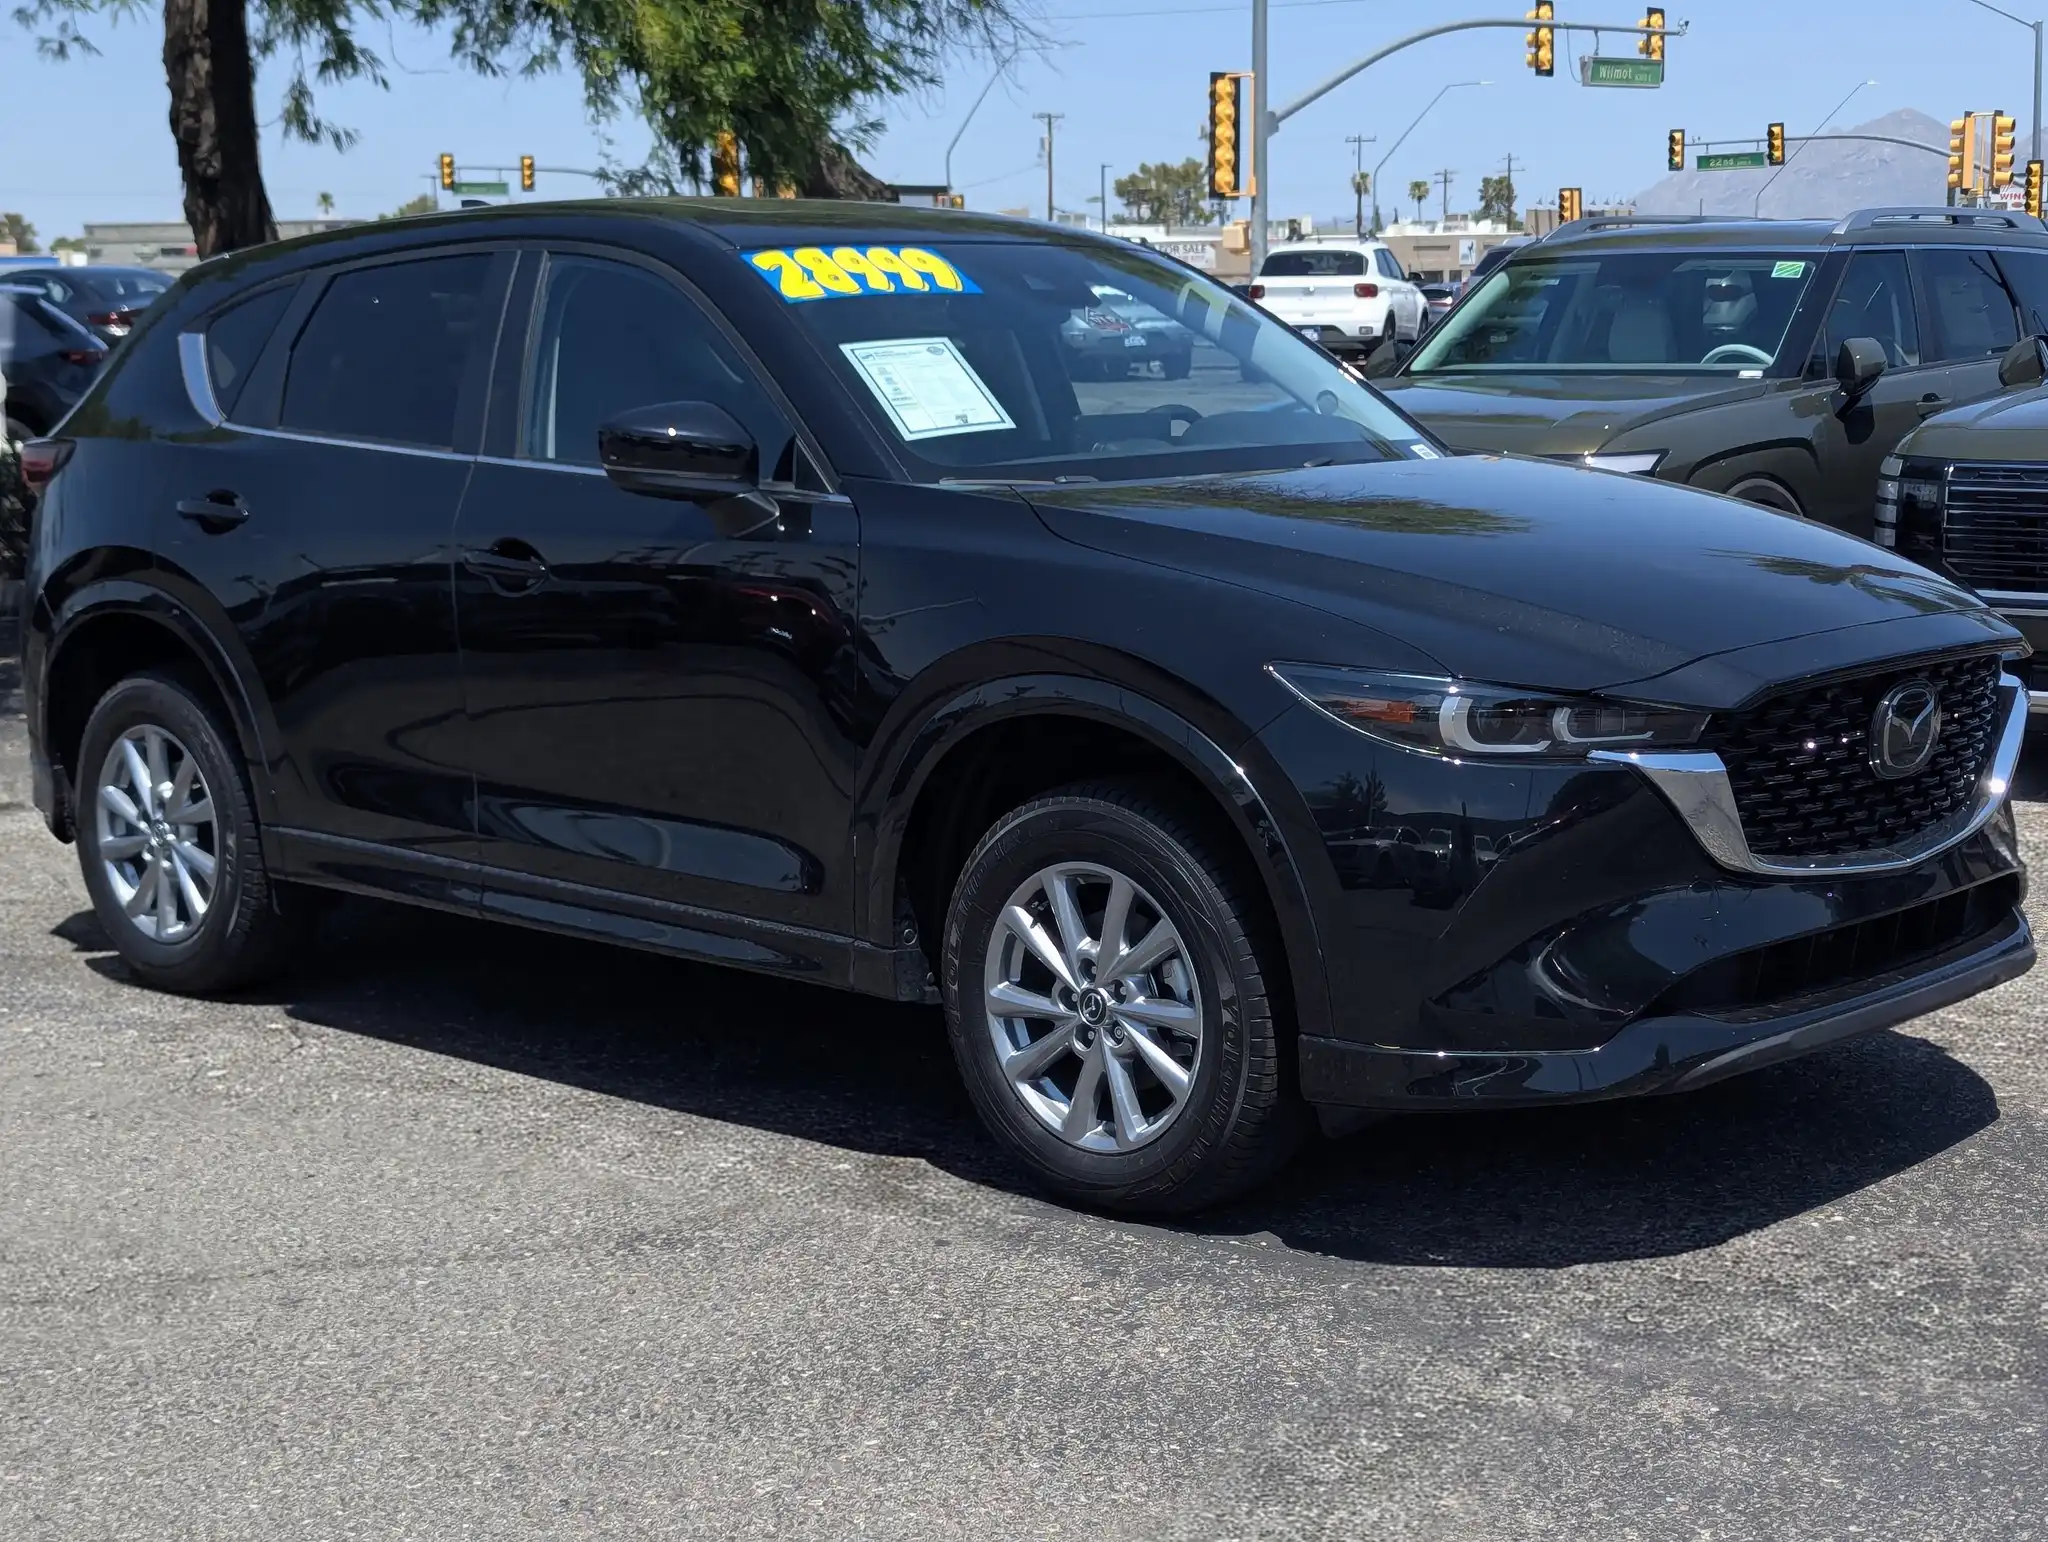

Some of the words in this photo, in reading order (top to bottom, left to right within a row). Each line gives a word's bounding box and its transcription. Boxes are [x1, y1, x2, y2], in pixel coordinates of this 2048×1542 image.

[1599, 64, 1632, 80] Wilmot
[1708, 157, 1734, 168] 22nd
[1159, 244, 1181, 255] FOR
[1183, 244, 1206, 253] SALE
[752, 246, 964, 299] 28999
